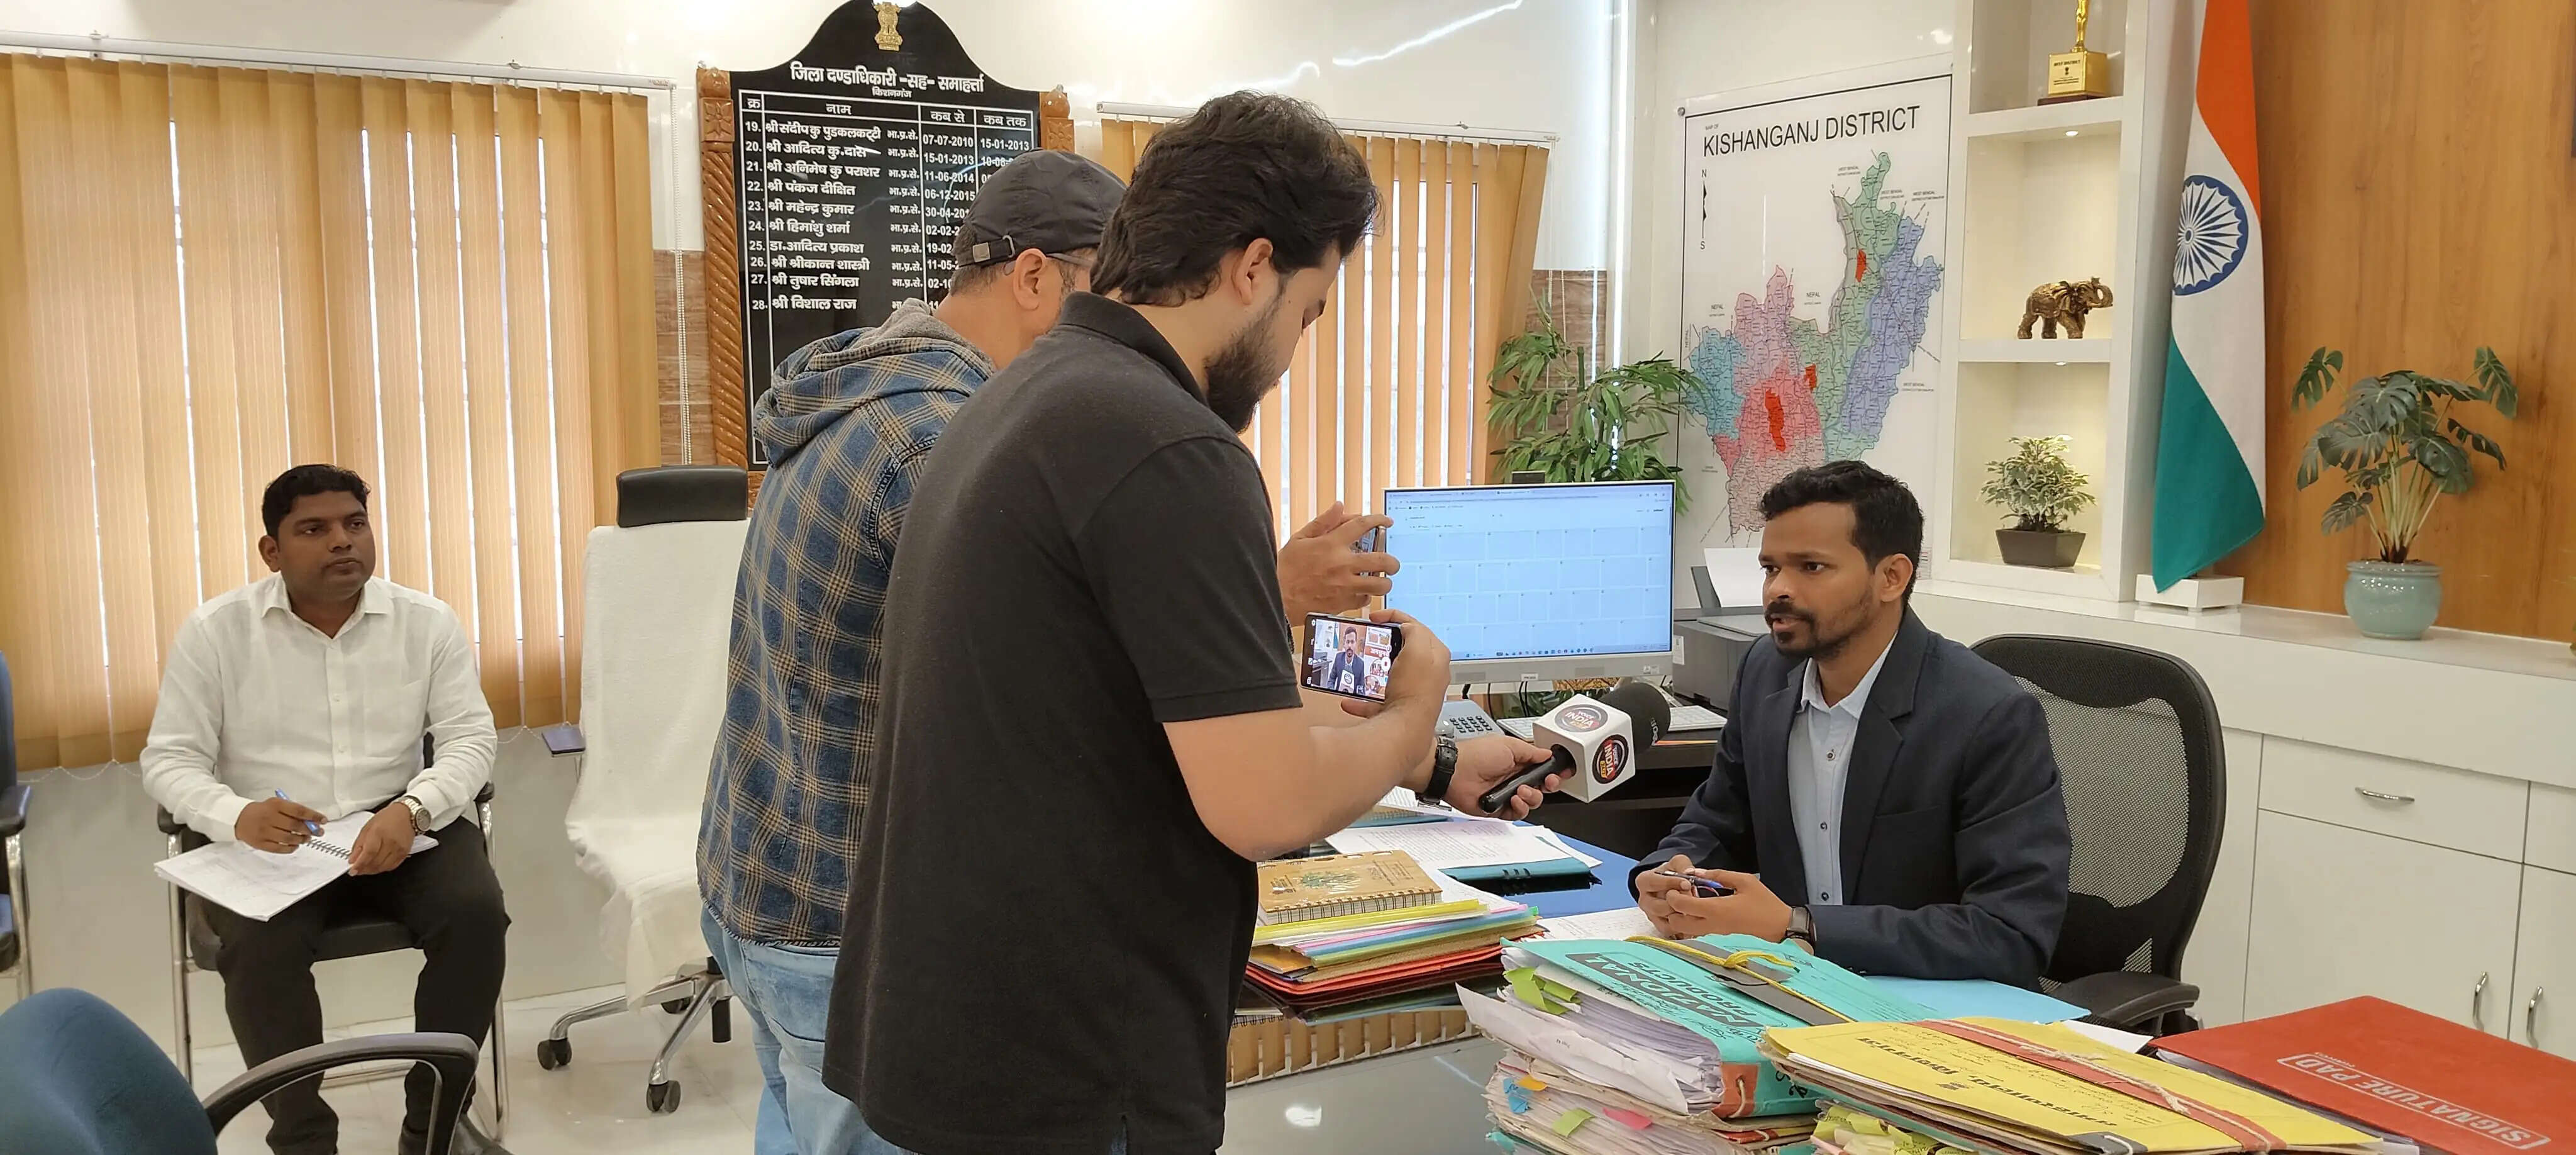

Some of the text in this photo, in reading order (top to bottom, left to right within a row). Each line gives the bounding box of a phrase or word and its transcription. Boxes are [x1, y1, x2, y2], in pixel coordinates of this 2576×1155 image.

[790, 60, 824, 82] जिला
[826, 64, 897, 87] दण्डाधिकारी
[872, 86, 912, 98] किशनगंज
[747, 98, 1027, 127] क्र नाम कब से कब तक
[745, 121, 762, 132] 19.
[887, 129, 918, 141] भा.प्र.से.
[922, 134, 974, 147] 07-07-2010
[980, 138, 1030, 151] 15-01-2013
[1703, 105, 1920, 157] KISHANGANJ DISTRICT
[745, 141, 762, 152] 20.
[766, 138, 782, 153] श्री
[784, 142, 825, 155] आदित्य
[887, 147, 919, 159] भा.प्र.से.
[923, 152, 974, 165] 15-01-2013
[746, 161, 763, 172] 21.
[767, 159, 782, 172] श्री
[784, 161, 827, 174] अनिमेष
[829, 164, 843, 179] कु
[845, 166, 880, 177] पराशर
[888, 169, 919, 180] भा.प्र.से.
[924, 170, 975, 184] 11-06-2014
[1701, 169, 1707, 177] N
[747, 180, 975, 201] 22. श्री पंकज दीक्षित भा.प्र.से. 06-12-2015
[747, 199, 969, 218] 23. श्री महेन्द्र कुमार भा.प्र.से. 30-04-201
[748, 218, 960, 237] 24. श्री हिमांशु शर्मा भा.प्र.से. 02-02-2
[749, 240, 766, 252] 25.
[830, 243, 865, 254] प्रकाश
[891, 243, 922, 254] भा.प्र.से.
[926, 243, 952, 253] 19-02
[1700, 240, 1706, 250] S
[750, 257, 767, 268] 26.
[771, 254, 787, 269] श्री
[789, 255, 836, 270] श्रीकान्त
[837, 257, 871, 271] शास्त्री
[892, 261, 923, 272] भा.प्र.से.
[751, 274, 768, 284] 27.
[771, 272, 787, 286] श्री
[789, 276, 819, 290] तुषार
[820, 274, 860, 287] सिंगला
[892, 277, 923, 288] भा.प्र.से.
[752, 294, 857, 310] 28. श्री विशाल राज
[1565, 712, 1594, 726] INDIA
[1604, 744, 1613, 776] INDIA
[1585, 957, 1748, 1024] NATIONAL
[1628, 961, 1757, 1017] PRODUCTS
[2294, 1057, 2530, 1142] SIGNATURE PAD
